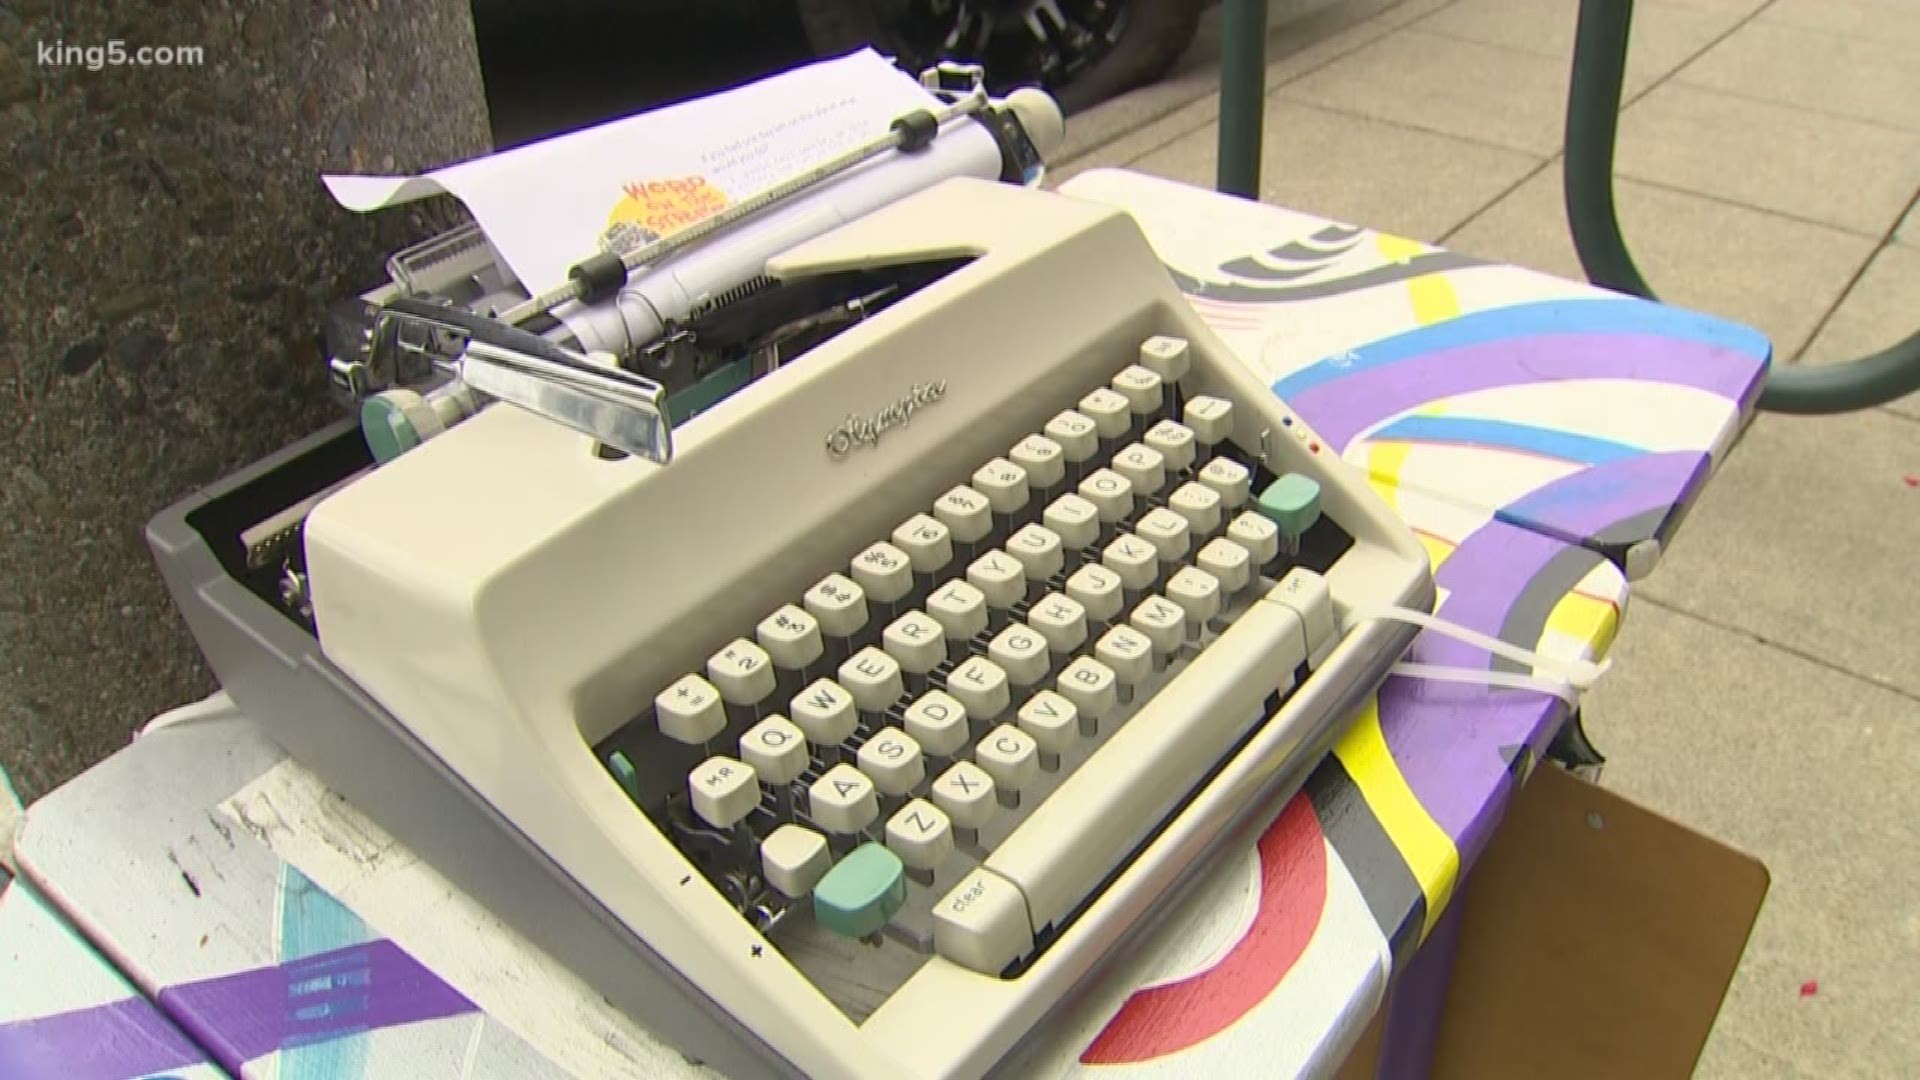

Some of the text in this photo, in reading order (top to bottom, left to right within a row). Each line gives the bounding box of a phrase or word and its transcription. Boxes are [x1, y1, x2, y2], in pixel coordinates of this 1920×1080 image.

[825, 378, 947, 456] Olympia
[1095, 478, 1118, 491] O
[1151, 519, 1177, 530] L
[1022, 533, 1046, 547] U
[1118, 542, 1144, 559] K
[983, 558, 1007, 574] Y
[1088, 573, 1107, 589] J
[942, 588, 967, 604] T
[1044, 603, 1073, 621] H
[1144, 602, 1175, 624] M
[902, 623, 930, 639] R
[1008, 635, 1033, 650] G
[1110, 635, 1139, 653] N
[856, 658, 886, 678] E
[965, 666, 986, 685] F
[1074, 668, 1101, 685] B
[806, 688, 837, 710] W
[922, 703, 950, 721] D
[1033, 701, 1061, 718] V
[760, 729, 793, 748] Q
[995, 737, 1021, 755] C
[877, 739, 905, 760] S
[832, 780, 861, 798] A
[949, 773, 980, 794] X
[904, 811, 936, 834] Z
[952, 879, 985, 912] clear
